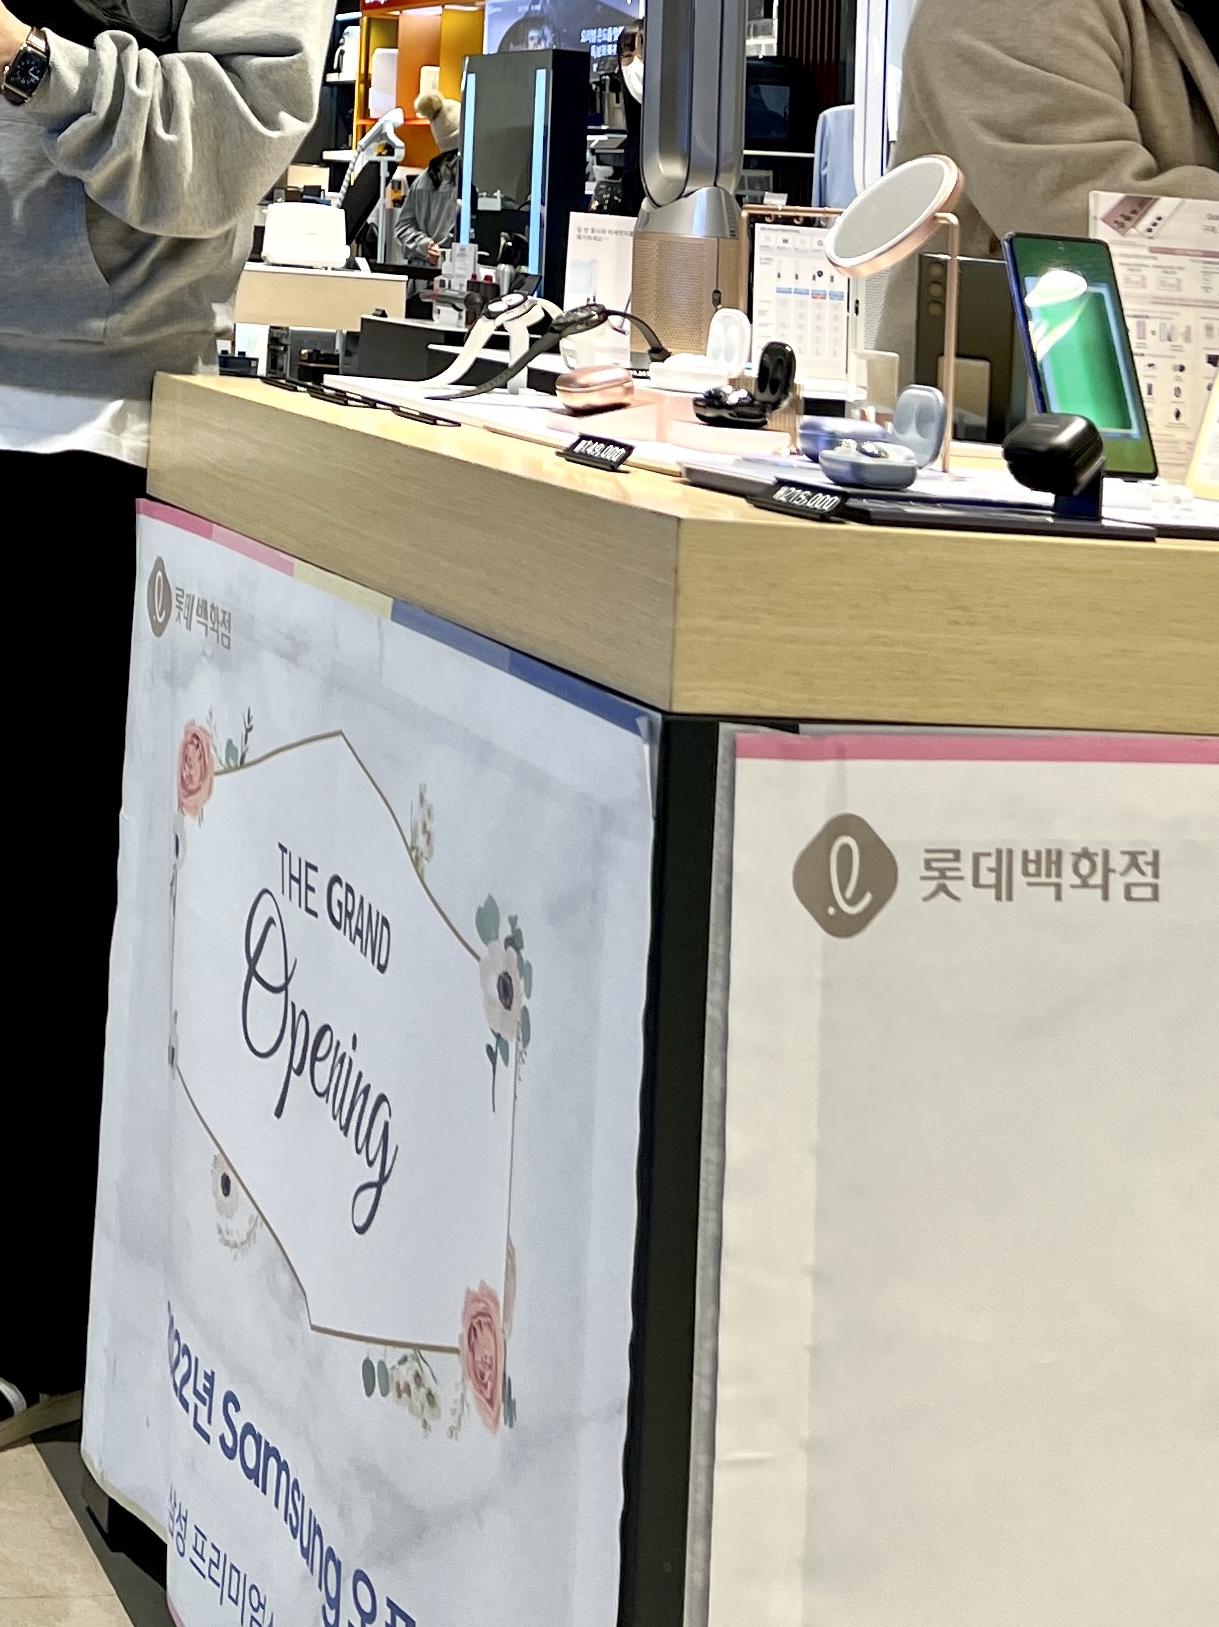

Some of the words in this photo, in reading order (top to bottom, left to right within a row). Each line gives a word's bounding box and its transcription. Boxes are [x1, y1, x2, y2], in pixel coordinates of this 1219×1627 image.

[175, 586, 232, 650] 롯데백화점
[277, 841, 319, 919] THE
[326, 873, 392, 975] GRAND
[919, 847, 1162, 903] 롯데백화점
[242, 887, 399, 1235] Opening
[218, 1389, 342, 1627] Samsung
